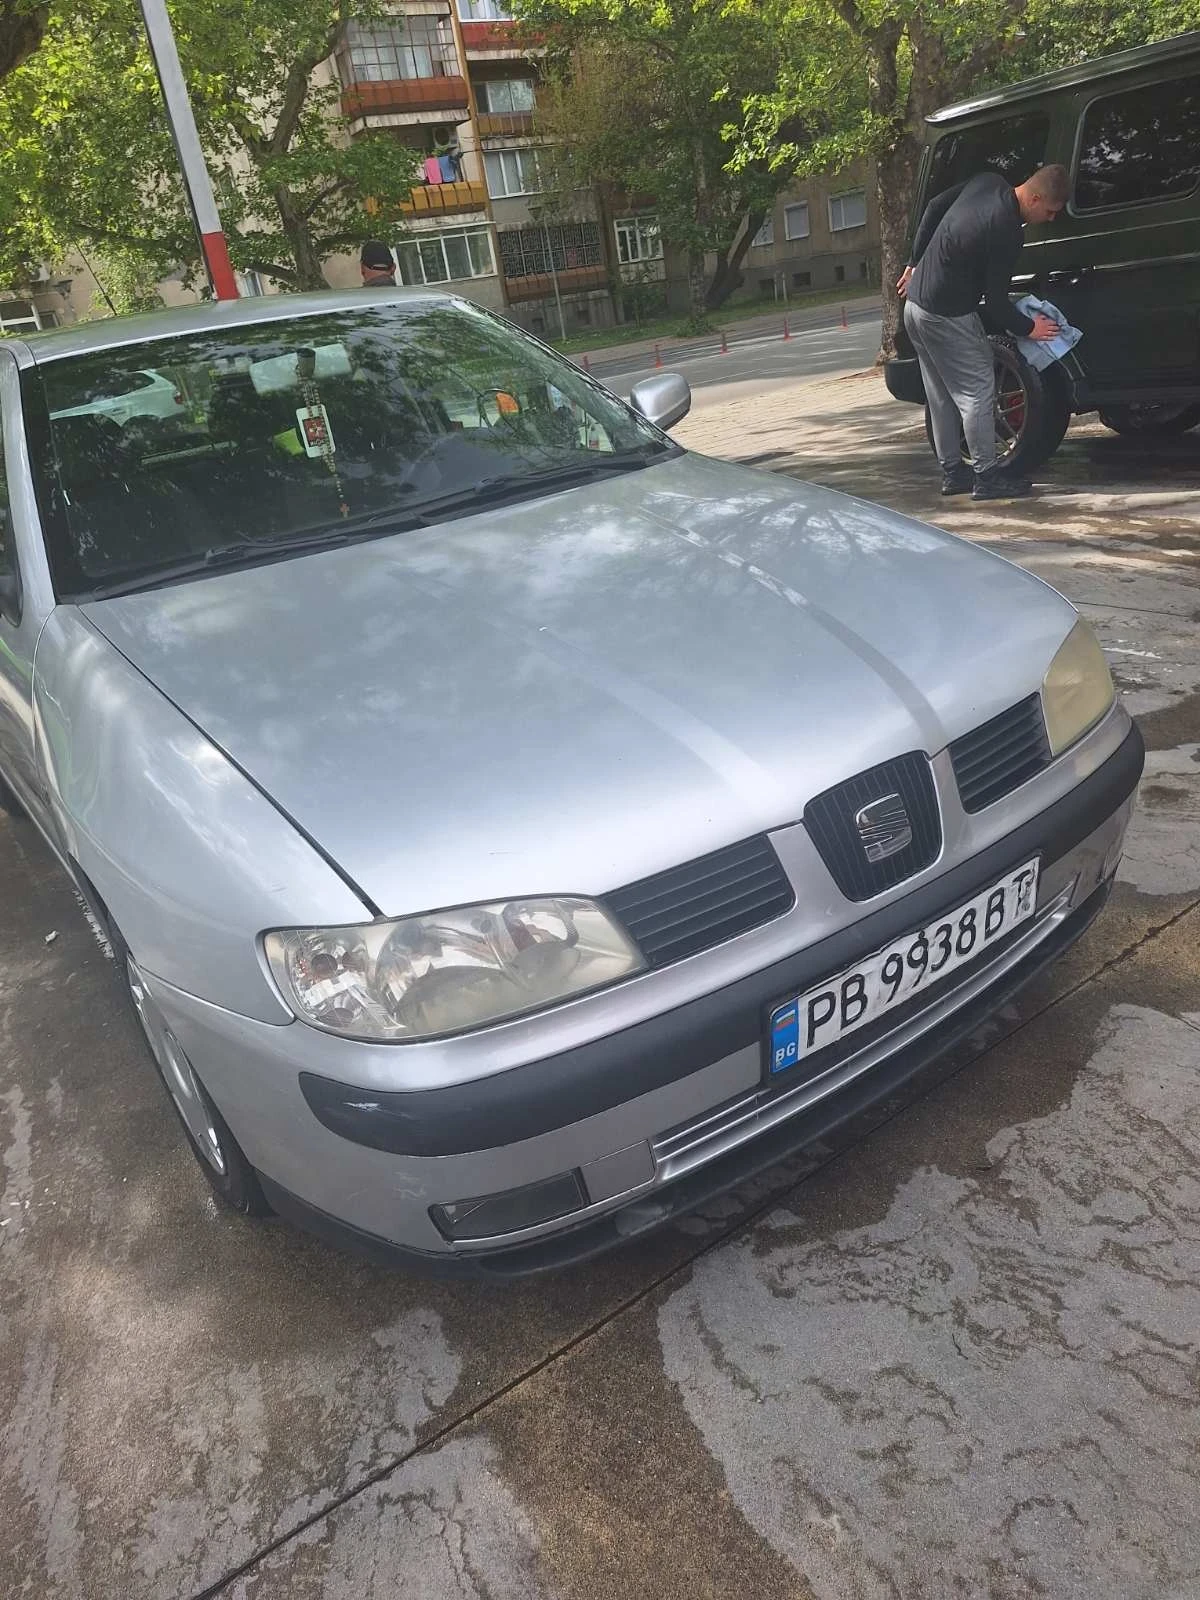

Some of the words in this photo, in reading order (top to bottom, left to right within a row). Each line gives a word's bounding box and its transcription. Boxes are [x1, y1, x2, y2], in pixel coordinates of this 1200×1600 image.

[807, 973, 867, 1048] PB
[881, 908, 976, 1004] 9938
[775, 1042, 796, 1066] BG
